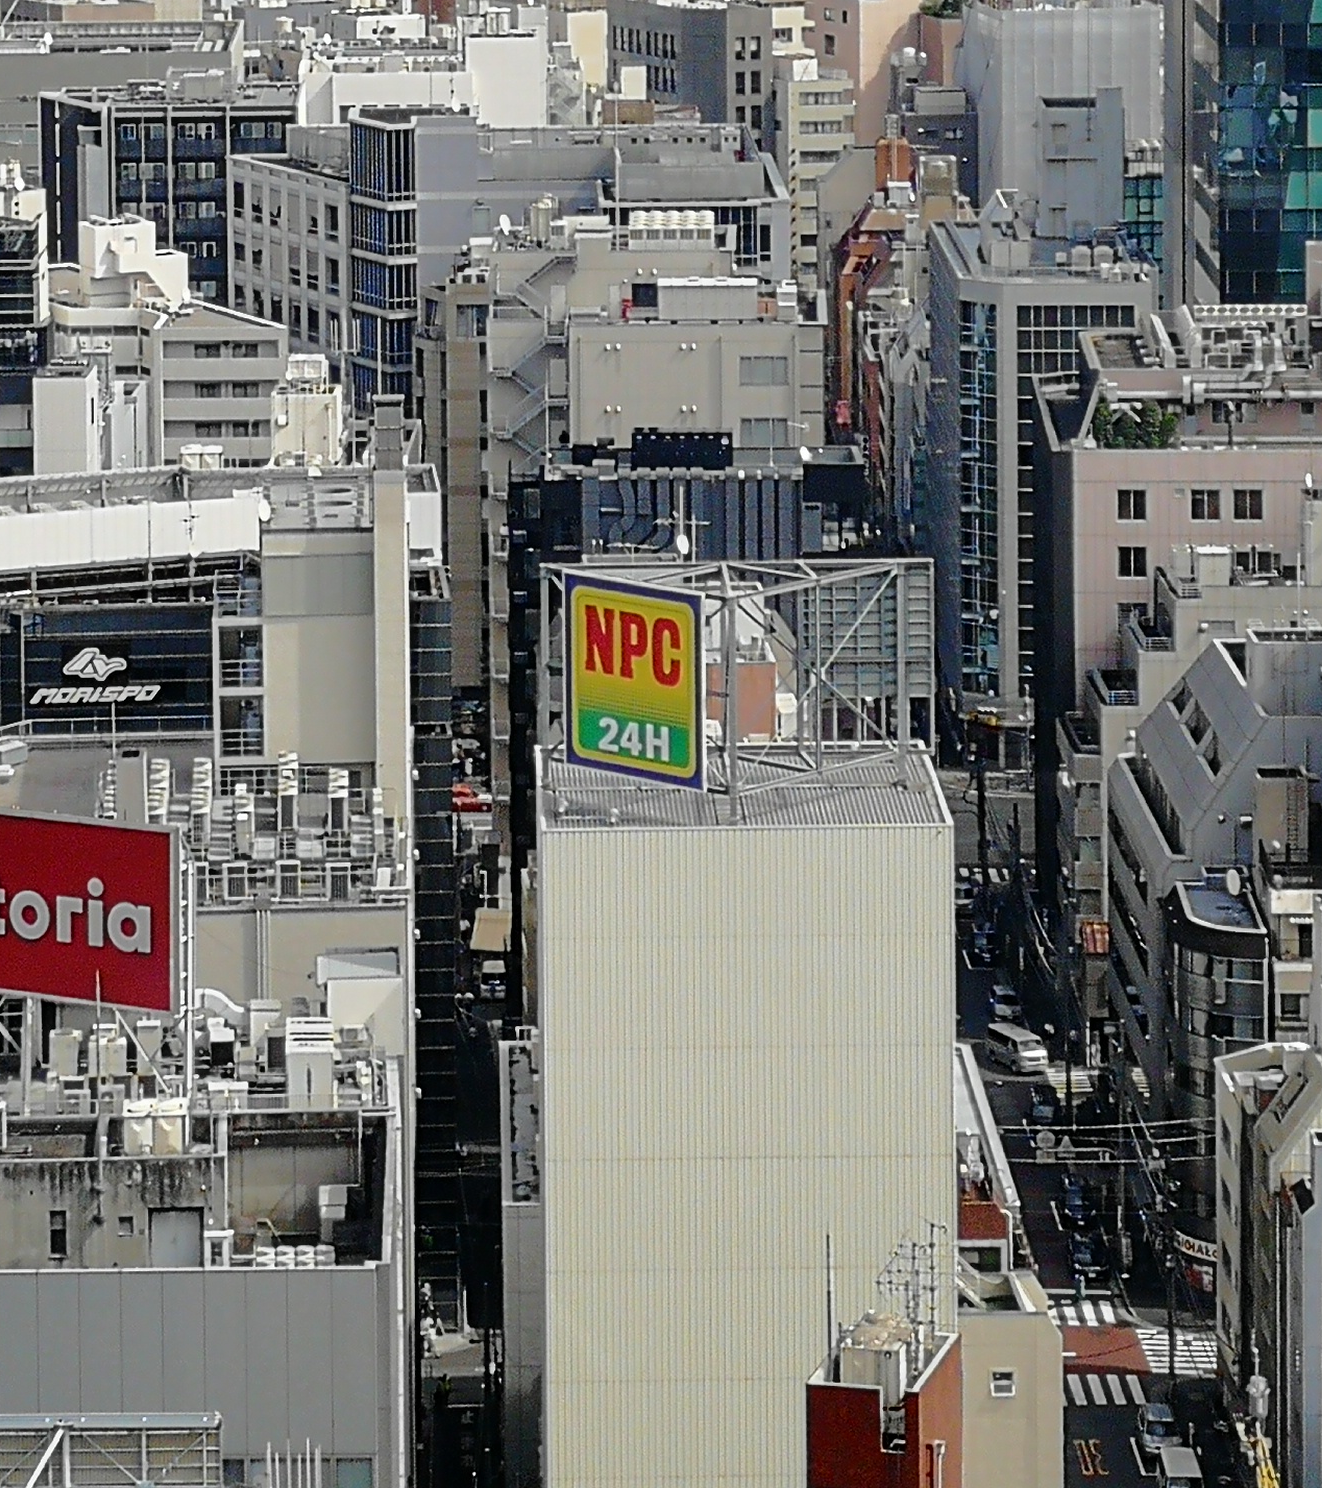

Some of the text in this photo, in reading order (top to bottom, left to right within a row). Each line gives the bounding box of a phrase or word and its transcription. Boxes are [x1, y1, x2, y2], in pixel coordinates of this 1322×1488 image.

[584, 604, 681, 687] NPC
[29, 685, 161, 705] MORISPO
[598, 716, 670, 762] 24H
